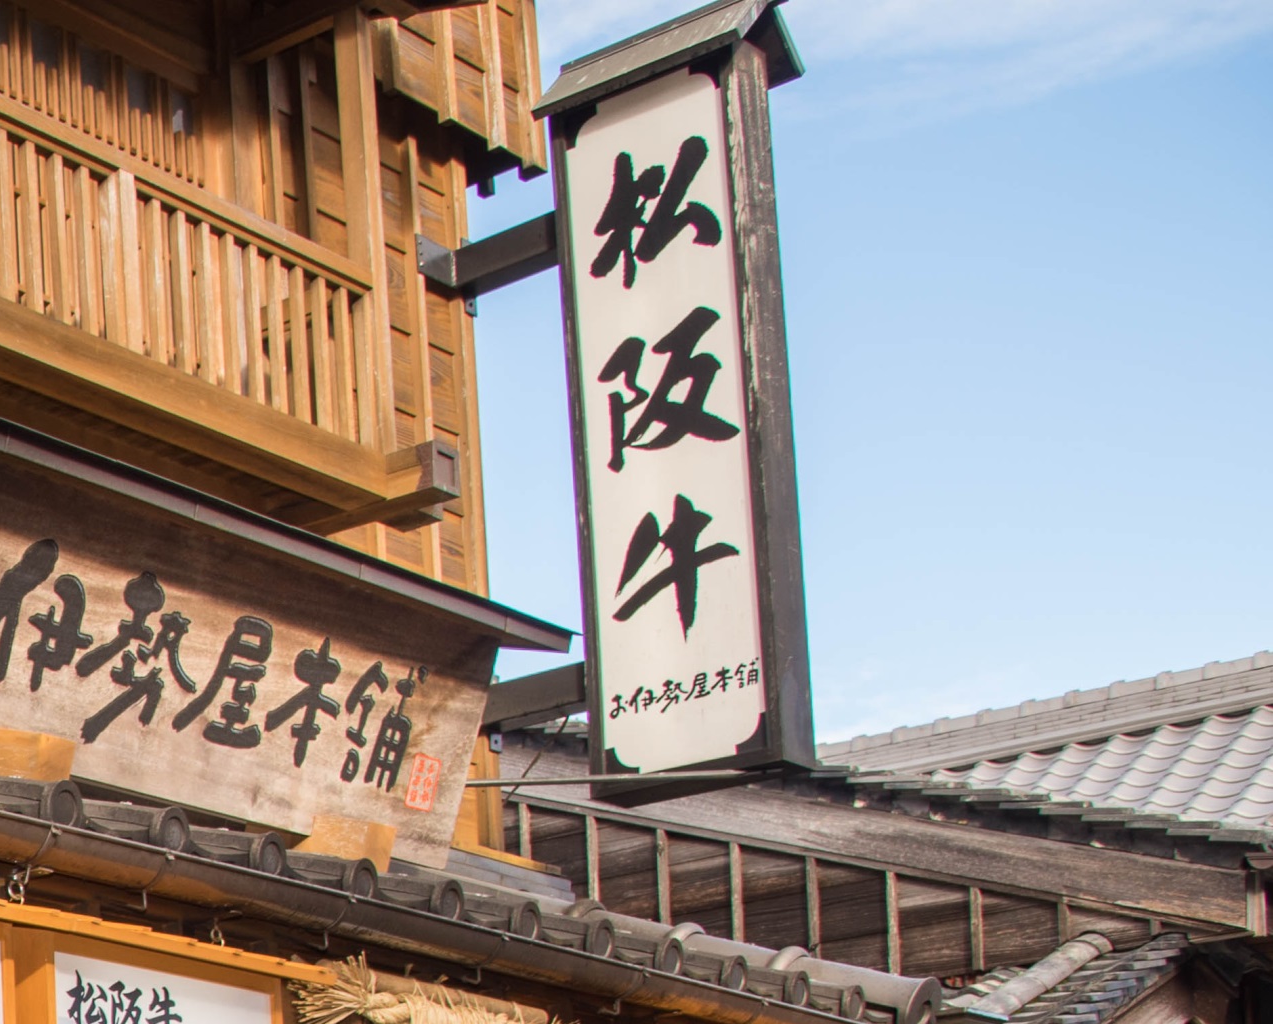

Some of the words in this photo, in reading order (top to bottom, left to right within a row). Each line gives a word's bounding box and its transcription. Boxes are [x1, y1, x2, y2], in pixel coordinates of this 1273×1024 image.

[590, 136, 741, 642] 松阪牛
[610, 657, 760, 719] お伊勢屋本舗
